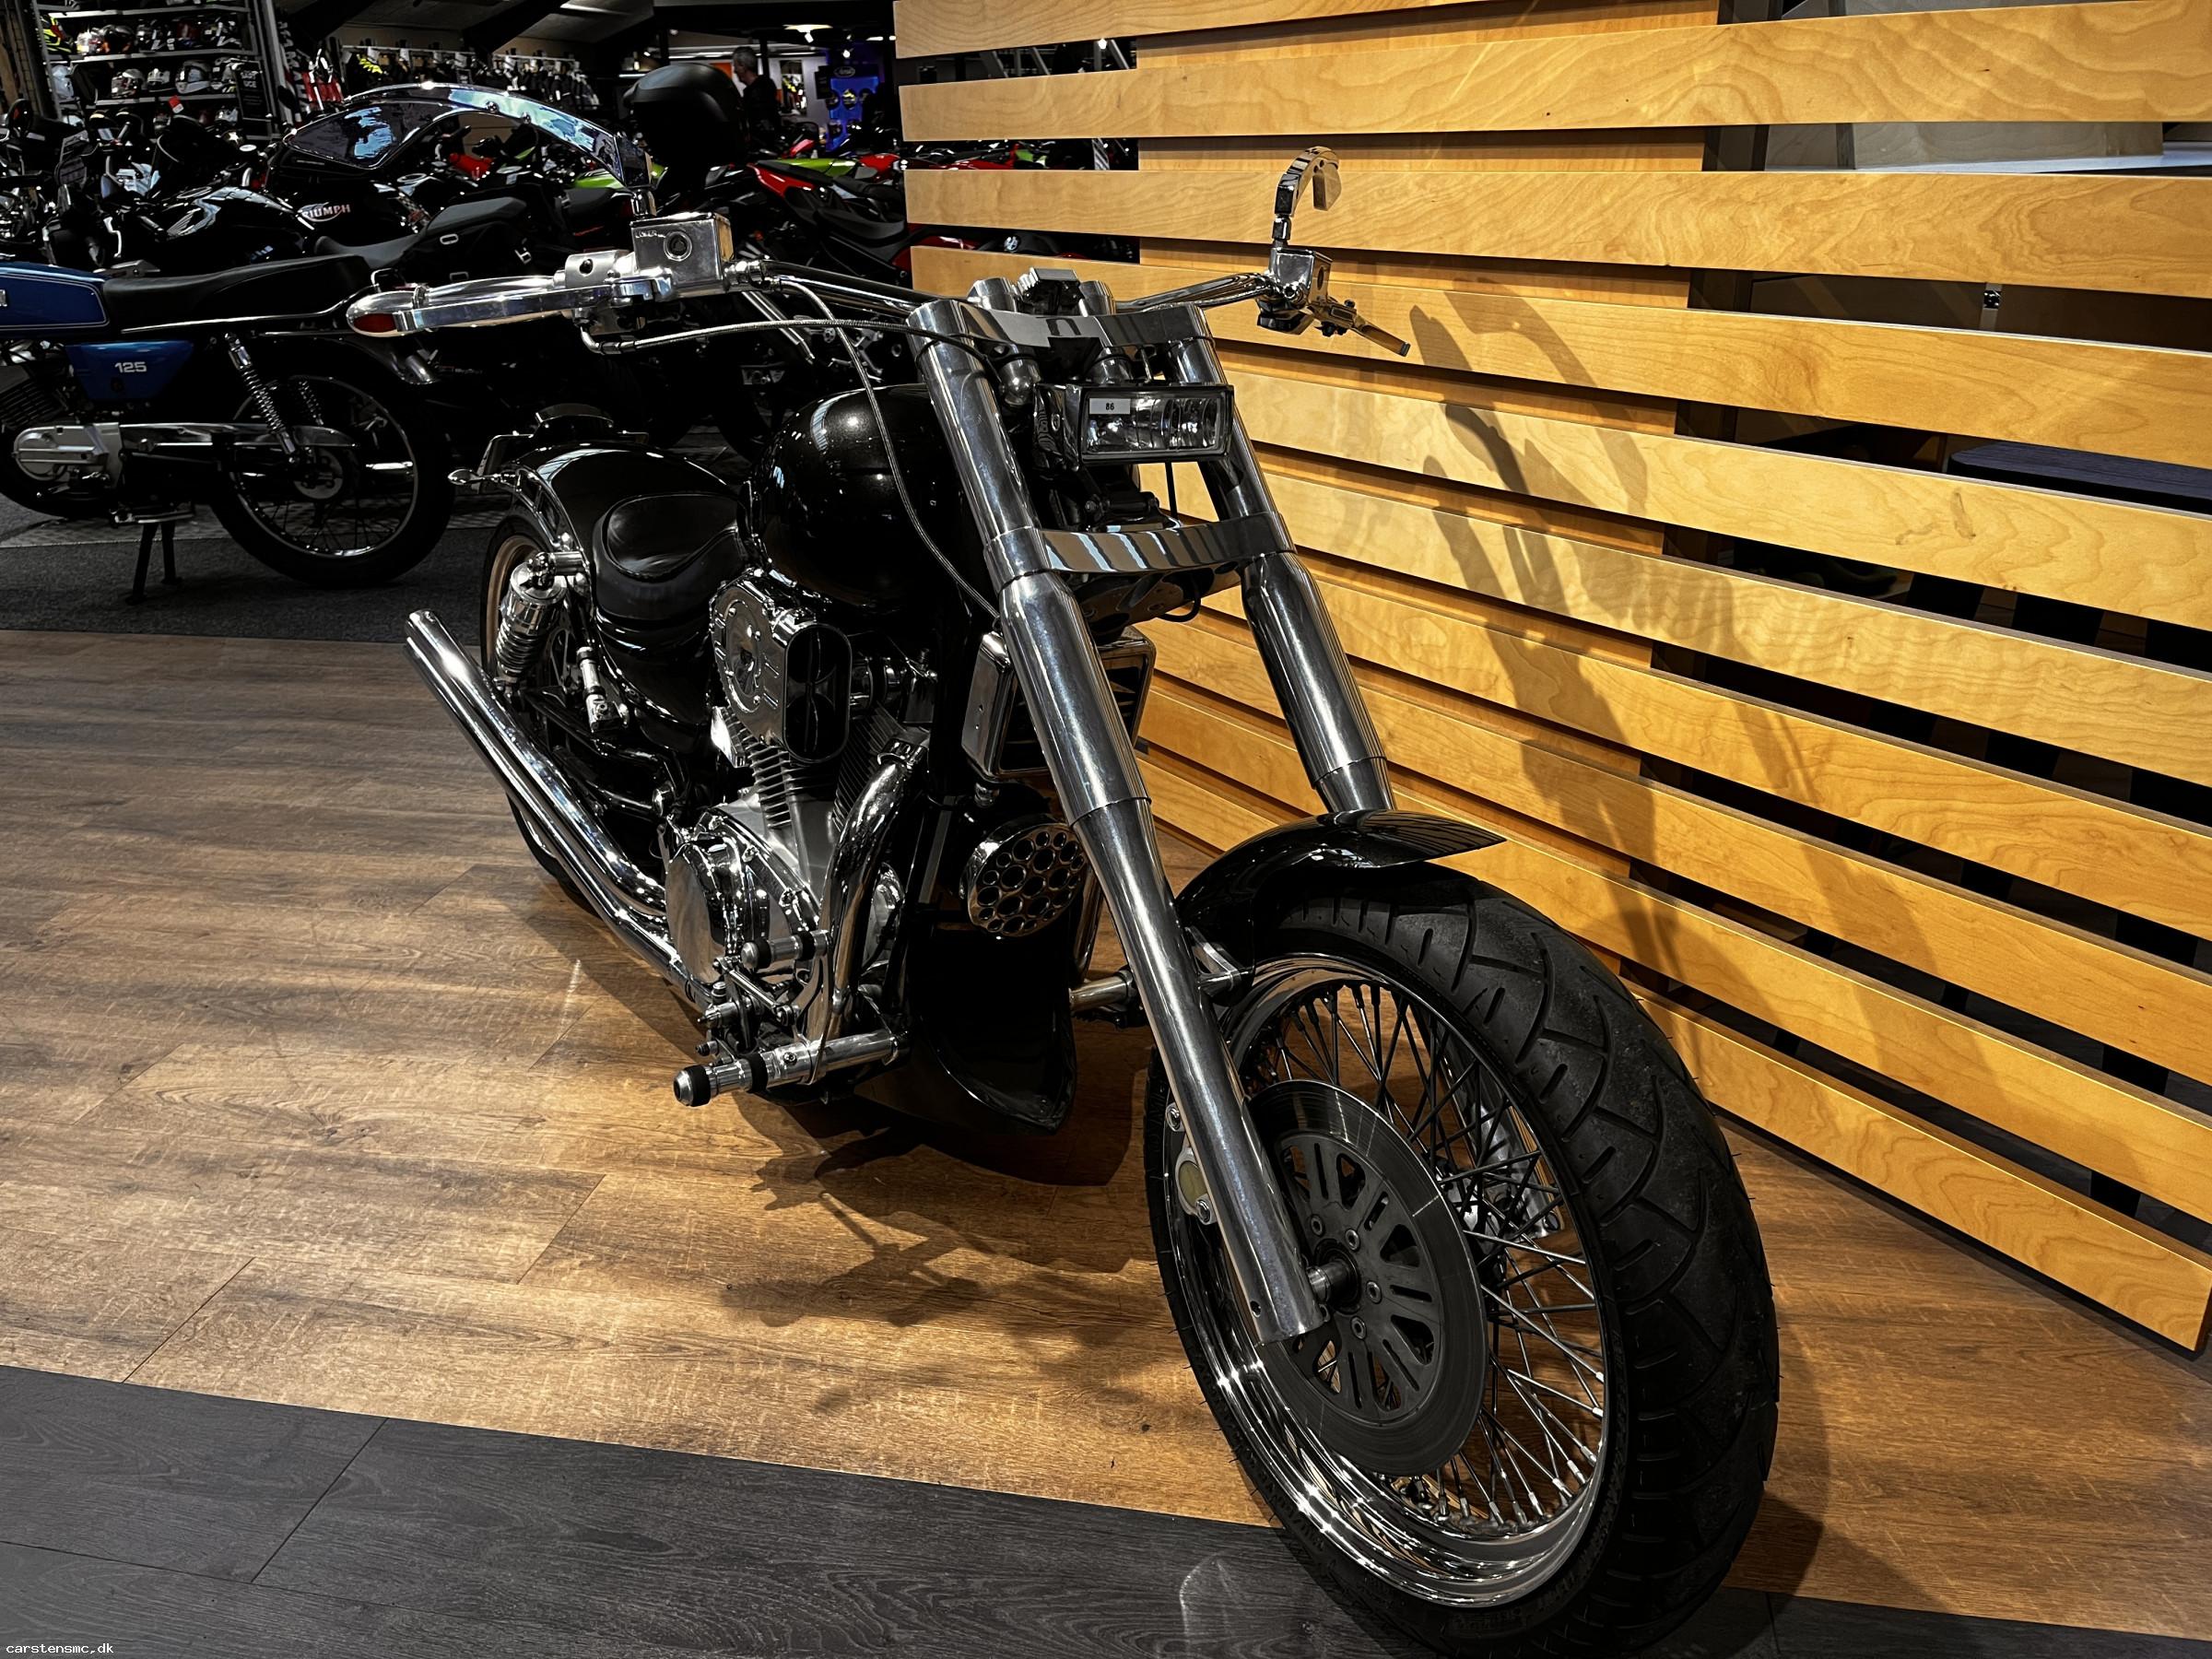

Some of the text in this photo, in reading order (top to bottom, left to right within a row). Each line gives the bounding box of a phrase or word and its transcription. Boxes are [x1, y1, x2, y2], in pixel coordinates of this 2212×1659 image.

[298, 204, 351, 221] RIUMPH
[114, 361, 147, 373] 125
[1105, 402, 1115, 411] 86
